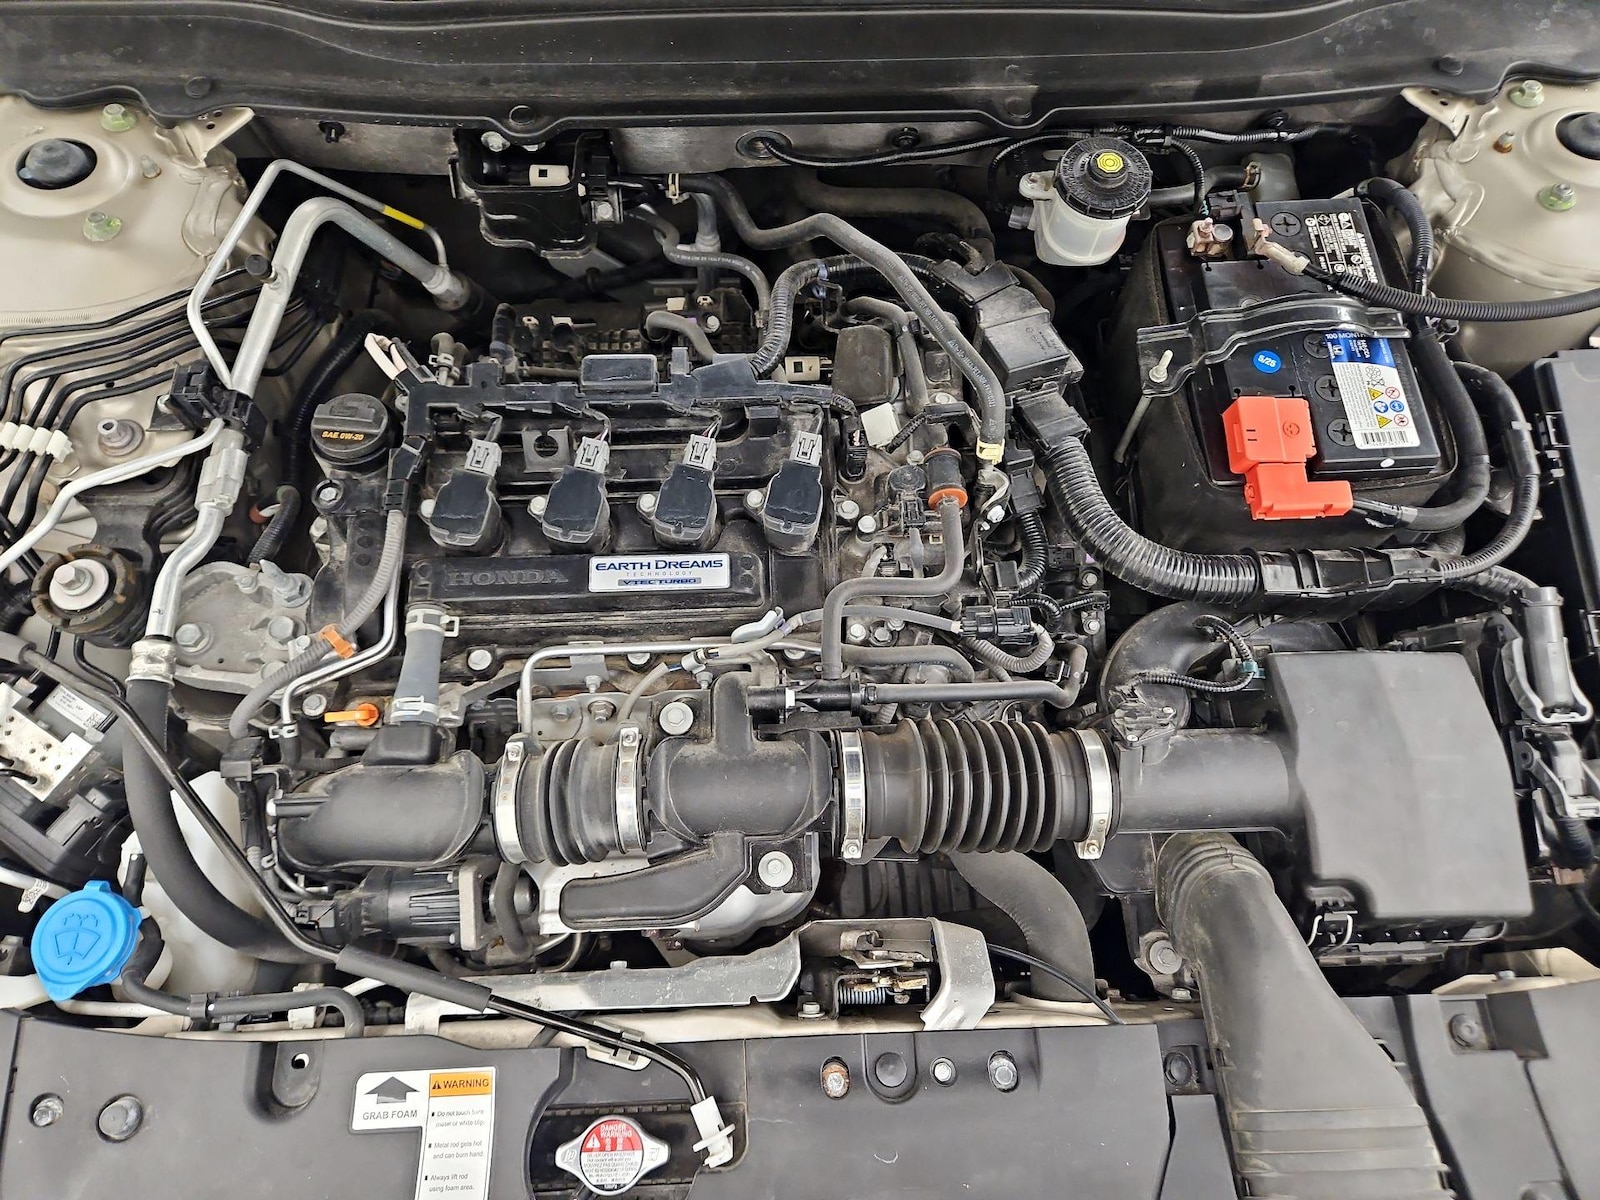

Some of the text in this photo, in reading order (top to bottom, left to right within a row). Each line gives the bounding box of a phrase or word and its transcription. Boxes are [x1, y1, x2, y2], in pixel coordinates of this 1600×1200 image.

[321, 430, 364, 441] SAE 0W-20
[595, 560, 723, 571] EARTH DREAMS
[447, 569, 569, 586] HONDA
[443, 1079, 489, 1089] WARNING
[362, 1110, 418, 1120] GRAB FOAM
[600, 1123, 627, 1131] DANGER
[431, 1174, 450, 1182] Always
